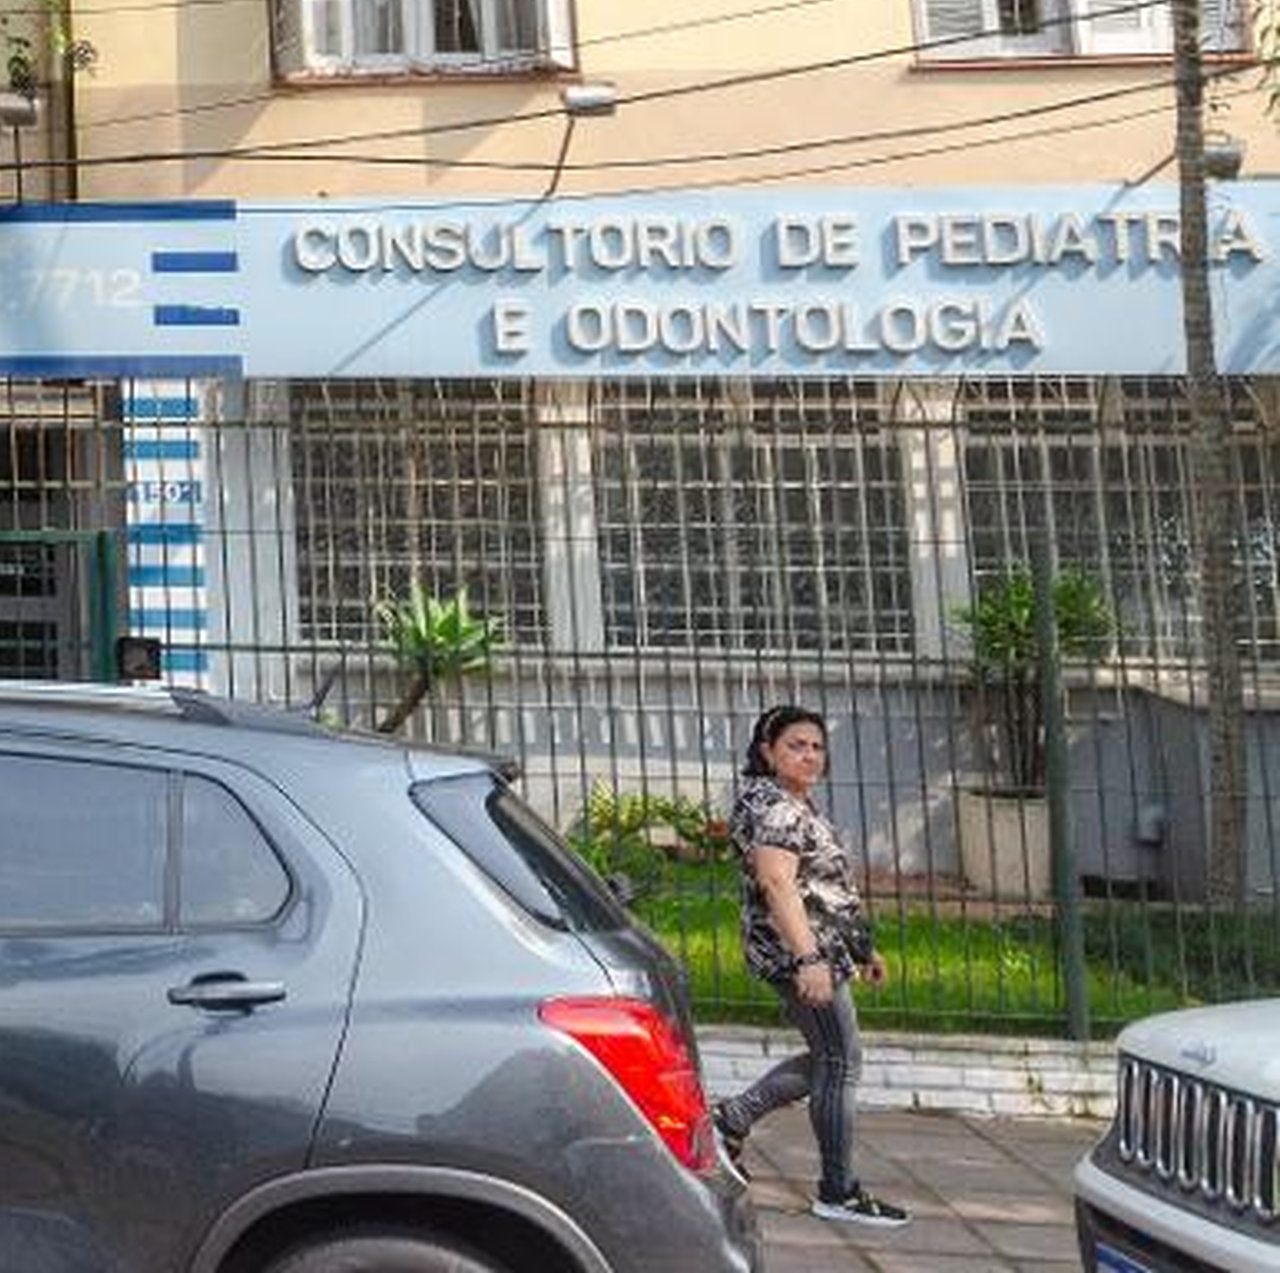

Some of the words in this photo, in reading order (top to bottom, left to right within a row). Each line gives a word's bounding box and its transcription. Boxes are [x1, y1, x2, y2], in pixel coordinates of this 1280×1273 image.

[293, 213, 738, 272] CONSULTORIO
[776, 212, 860, 268] DE
[894, 209, 1263, 267] PEDIATRA
[492, 298, 532, 354] E
[567, 295, 1046, 354] ODONTOLOGIA
